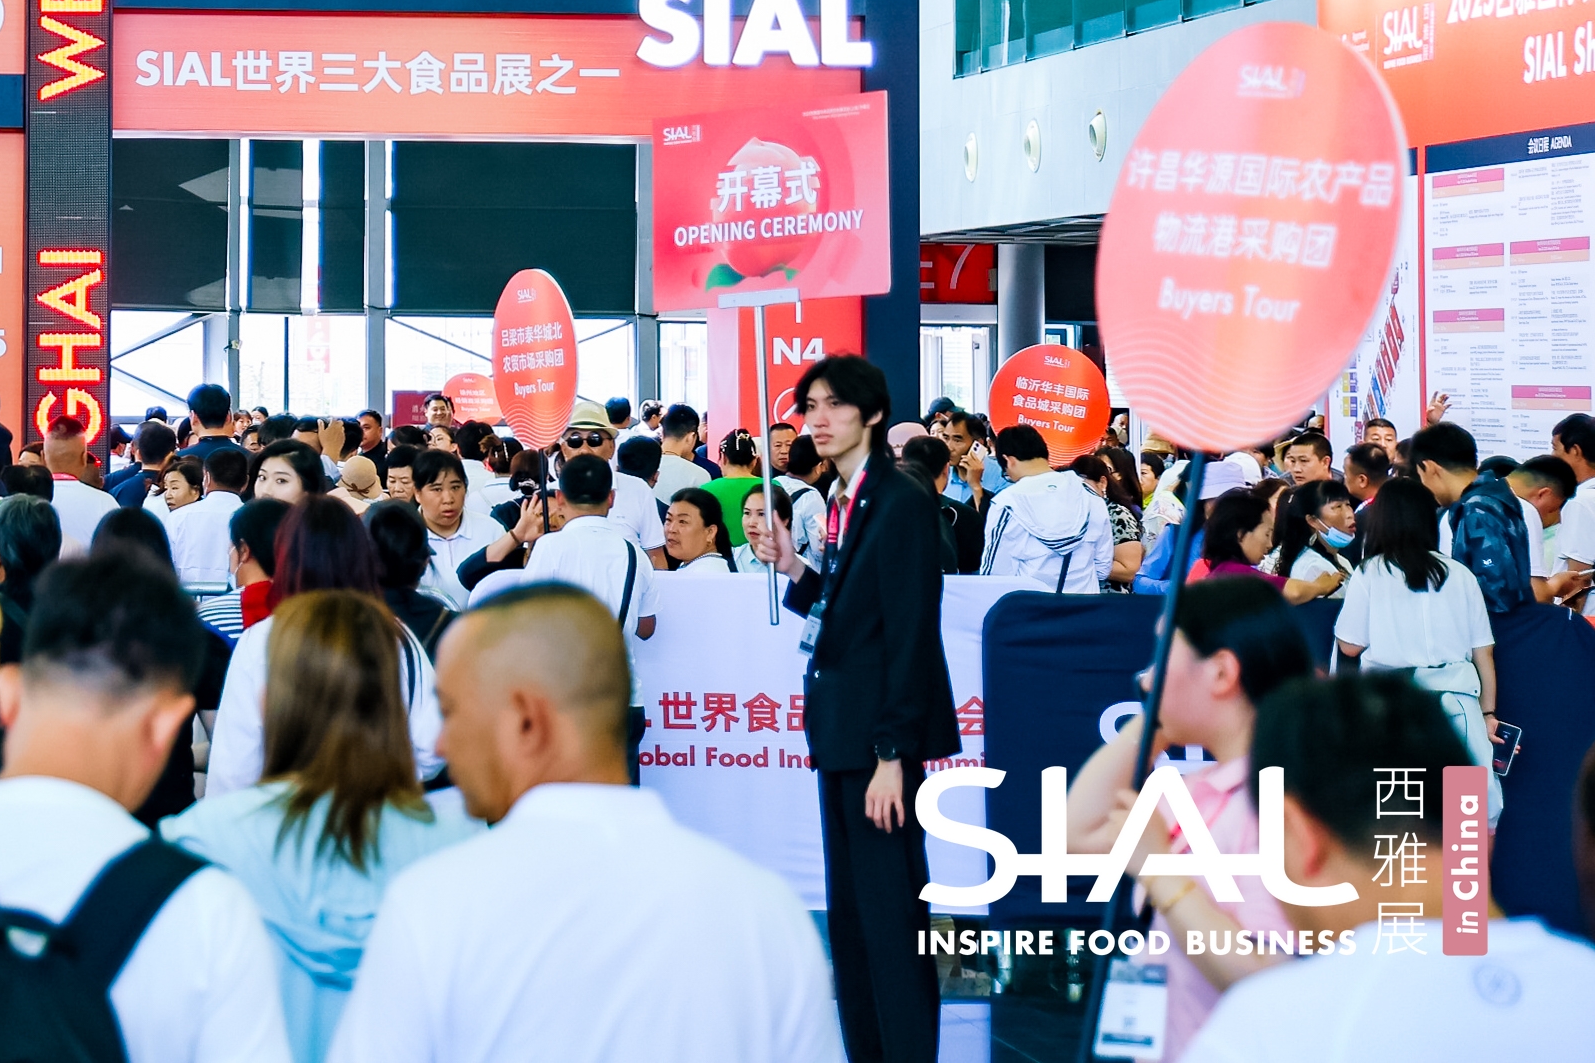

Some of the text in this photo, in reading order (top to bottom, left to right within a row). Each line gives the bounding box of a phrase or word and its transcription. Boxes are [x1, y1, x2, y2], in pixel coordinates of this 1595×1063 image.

[1383, 4, 1424, 56] SIAL
[1523, 30, 1567, 84] SIAL
[135, 49, 621, 97] SIAL世界三大食品展之一
[662, 125, 693, 143] SIAL
[1550, 135, 1573, 151] AGENDA
[716, 161, 818, 214] 开幕式
[1127, 148, 1397, 209] 许昌华源国际农产品
[674, 209, 864, 247] OPENING CEREMONY
[1153, 211, 1337, 268] 物流港采购团
[1158, 277, 1302, 323] Buyers Tour
[501, 321, 563, 348] 吕梁市泰华城北
[502, 348, 565, 374] 农贸市场采购团
[772, 337, 826, 366] N4
[514, 378, 555, 399] Buyers Tour
[1015, 376, 1090, 401] 临沂华丰国际
[1012, 393, 1087, 419] 食品城采购团
[1018, 414, 1075, 433] Buyers Tour
[706, 746, 769, 768] Food
